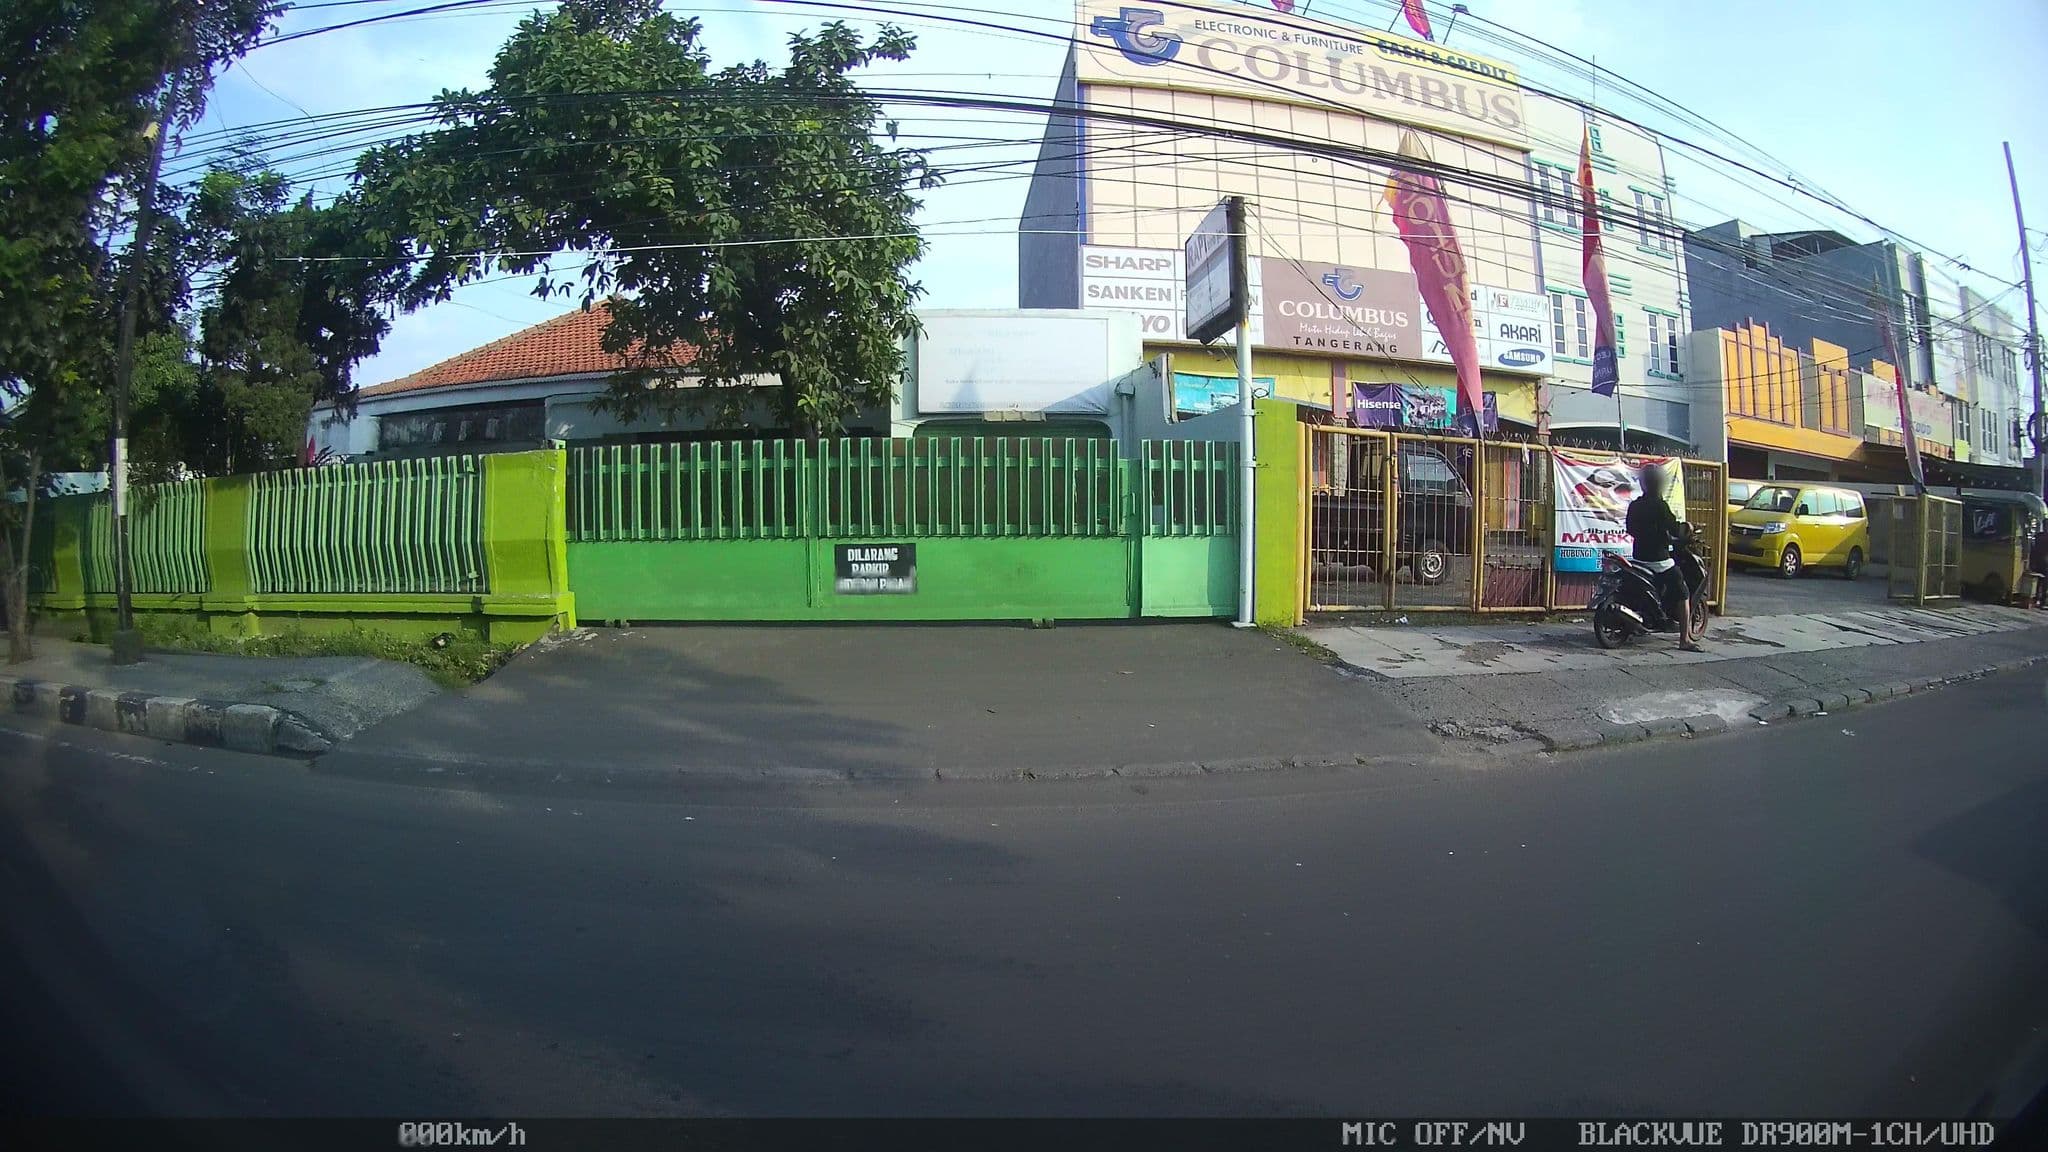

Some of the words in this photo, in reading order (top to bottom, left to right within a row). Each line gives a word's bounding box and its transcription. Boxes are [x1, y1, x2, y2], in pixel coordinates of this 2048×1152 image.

[1194, 19, 1277, 40] ELECTRONIC
[1282, 31, 1291, 42] &
[1295, 33, 1364, 55] FURNITURE
[1377, 40, 1428, 62] CASH
[1447, 55, 1509, 81] CREDIT
[1197, 38, 1522, 130] COLUMBUS
[1085, 254, 1172, 271] SHARP
[1087, 284, 1172, 302] SANKEN
[1278, 300, 1409, 328] COLUMBUS
[1293, 335, 1398, 353] TANGERANG
[1503, 350, 1542, 364] SAMSUNG
[1356, 398, 1401, 410] Hisense
[847, 547, 899, 562] DILARANG
[1560, 549, 1592, 558] HUBUNGI
